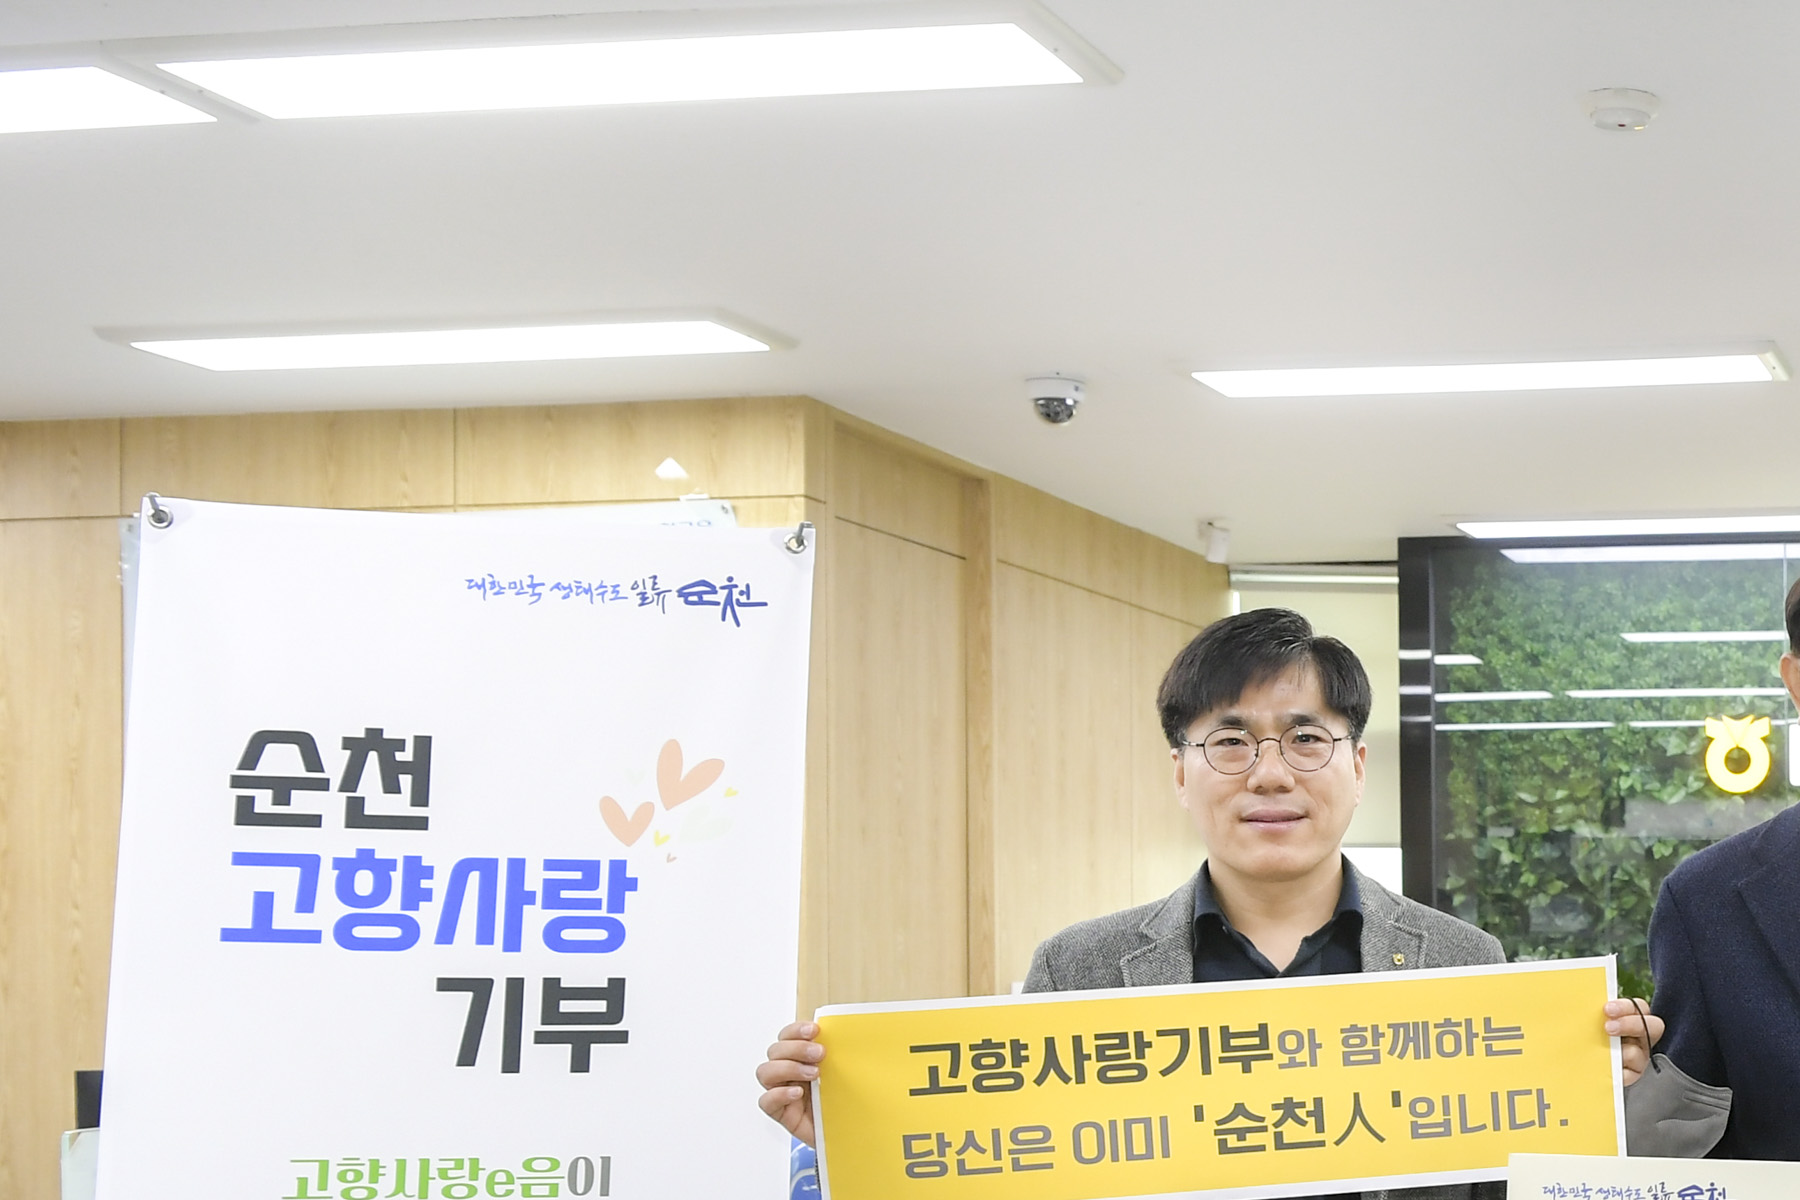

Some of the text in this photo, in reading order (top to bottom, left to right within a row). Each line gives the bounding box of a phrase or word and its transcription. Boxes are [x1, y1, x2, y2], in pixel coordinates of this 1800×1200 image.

[465, 573, 768, 628] 대한민국 생태수도 일류 순천
[229, 728, 432, 830] 순천
[220, 849, 638, 953] 고향사랑
[436, 977, 629, 1073] 기부
[908, 1017, 1524, 1098] 고향사랑기부와 함께하는
[901, 1122, 1056, 1180] 당신은
[1072, 1114, 1171, 1166] 이미
